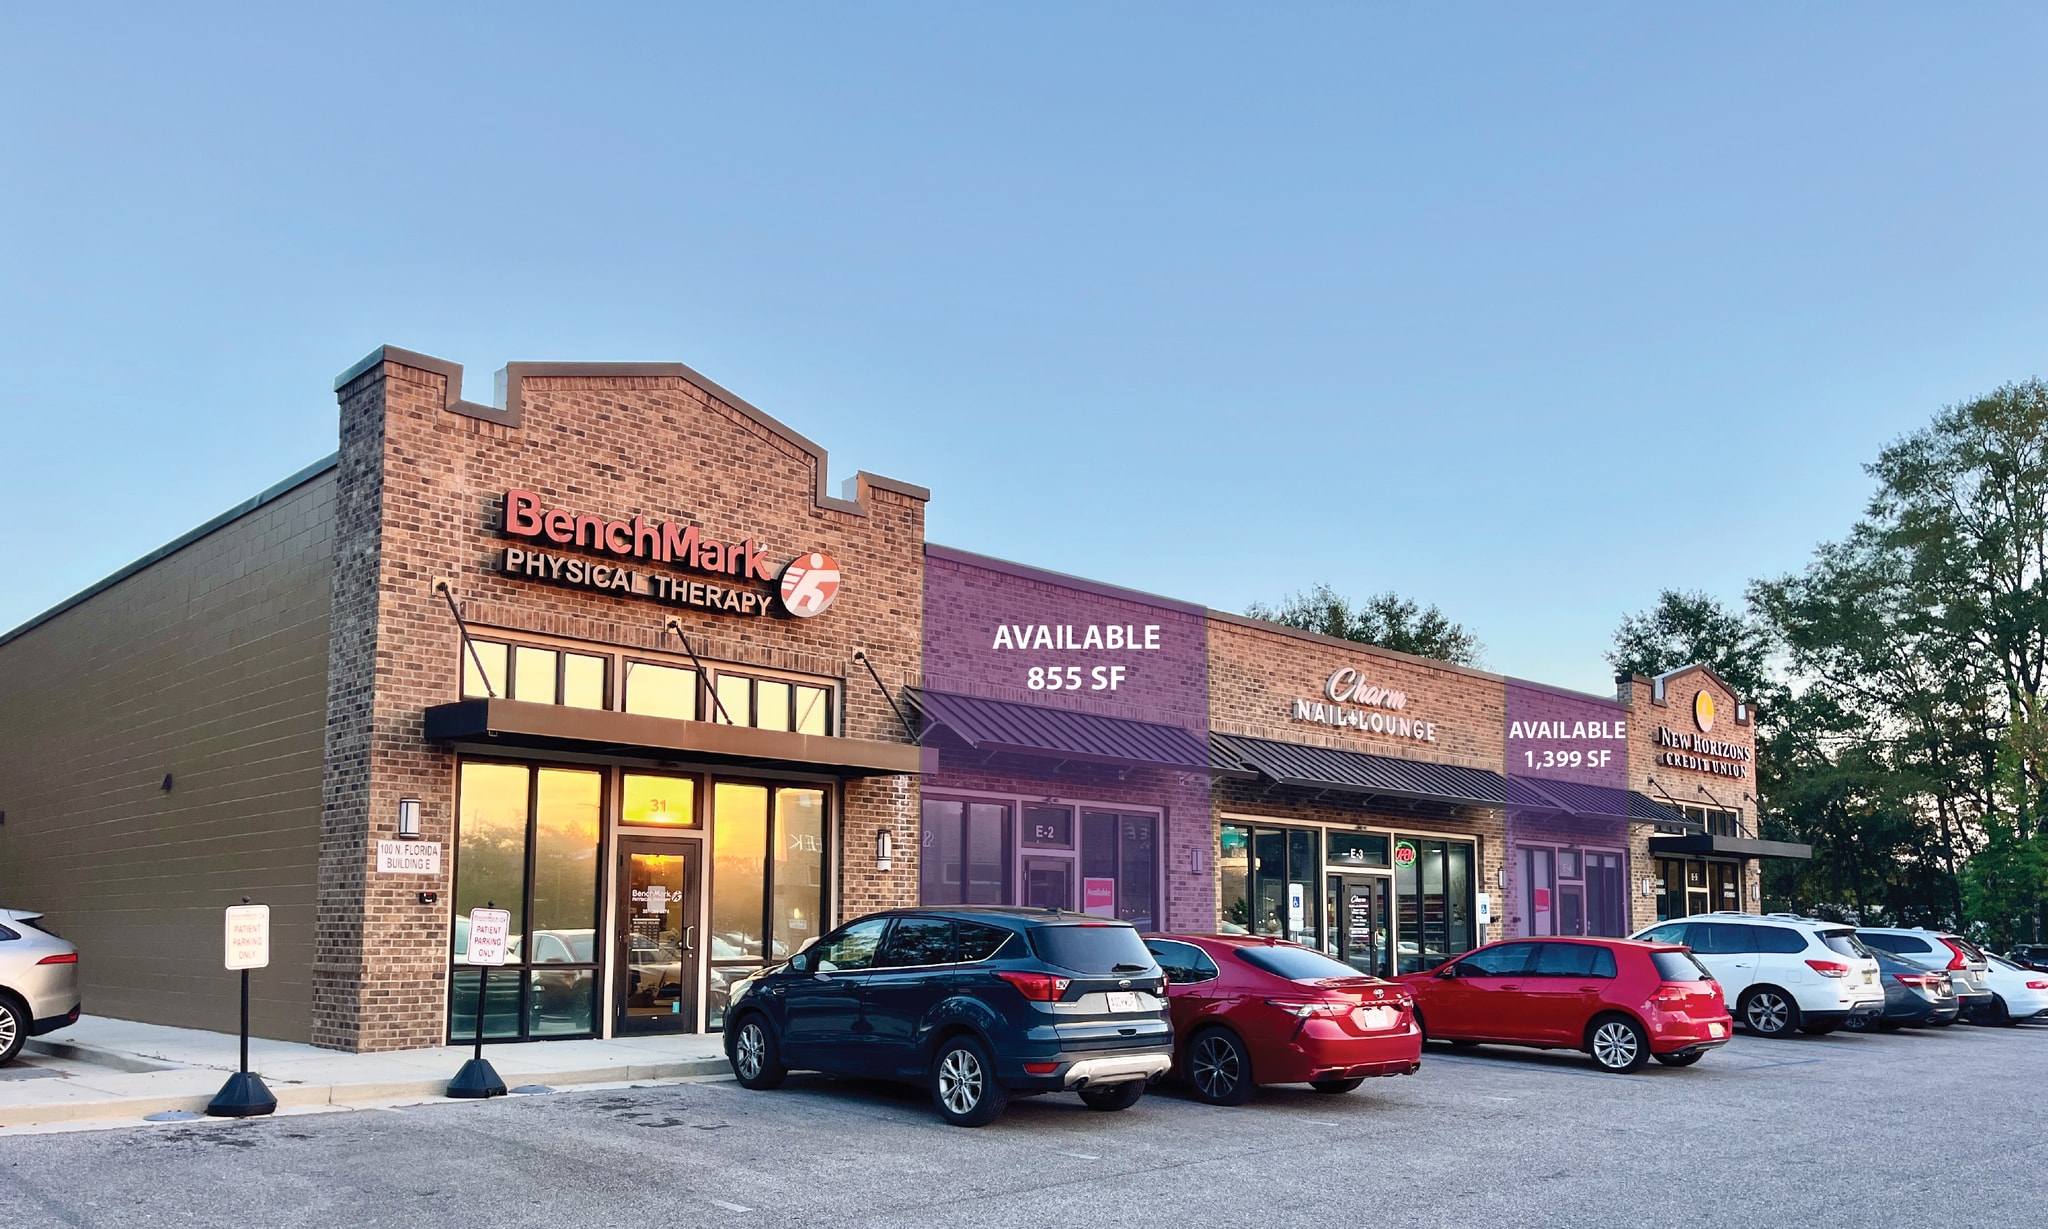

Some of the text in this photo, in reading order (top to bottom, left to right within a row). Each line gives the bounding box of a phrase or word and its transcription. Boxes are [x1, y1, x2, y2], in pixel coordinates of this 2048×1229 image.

[505, 489, 771, 581] BenchMark
[505, 548, 772, 617] PHYSICAL THERAPY
[1327, 667, 1407, 710] Charm
[1296, 699, 1436, 741] NAIL LOUNGE
[1661, 727, 1751, 761] NEW HORIZONS
[1666, 752, 1747, 778] CREDIT UNION
[649, 799, 666, 812] 31
[1035, 825, 1054, 839] E-2
[381, 843, 394, 855] 100
[404, 844, 438, 856] FLORIDA
[1350, 848, 1364, 860] E-3
[387, 857, 431, 870] BUILDING E
[234, 924, 261, 934] PATIENT
[476, 925, 502, 935] PATIENT
[233, 937, 262, 947] PARKING
[474, 937, 502, 946] PARKING
[239, 951, 256, 960] ONLY
[478, 949, 495, 958] ONLY
